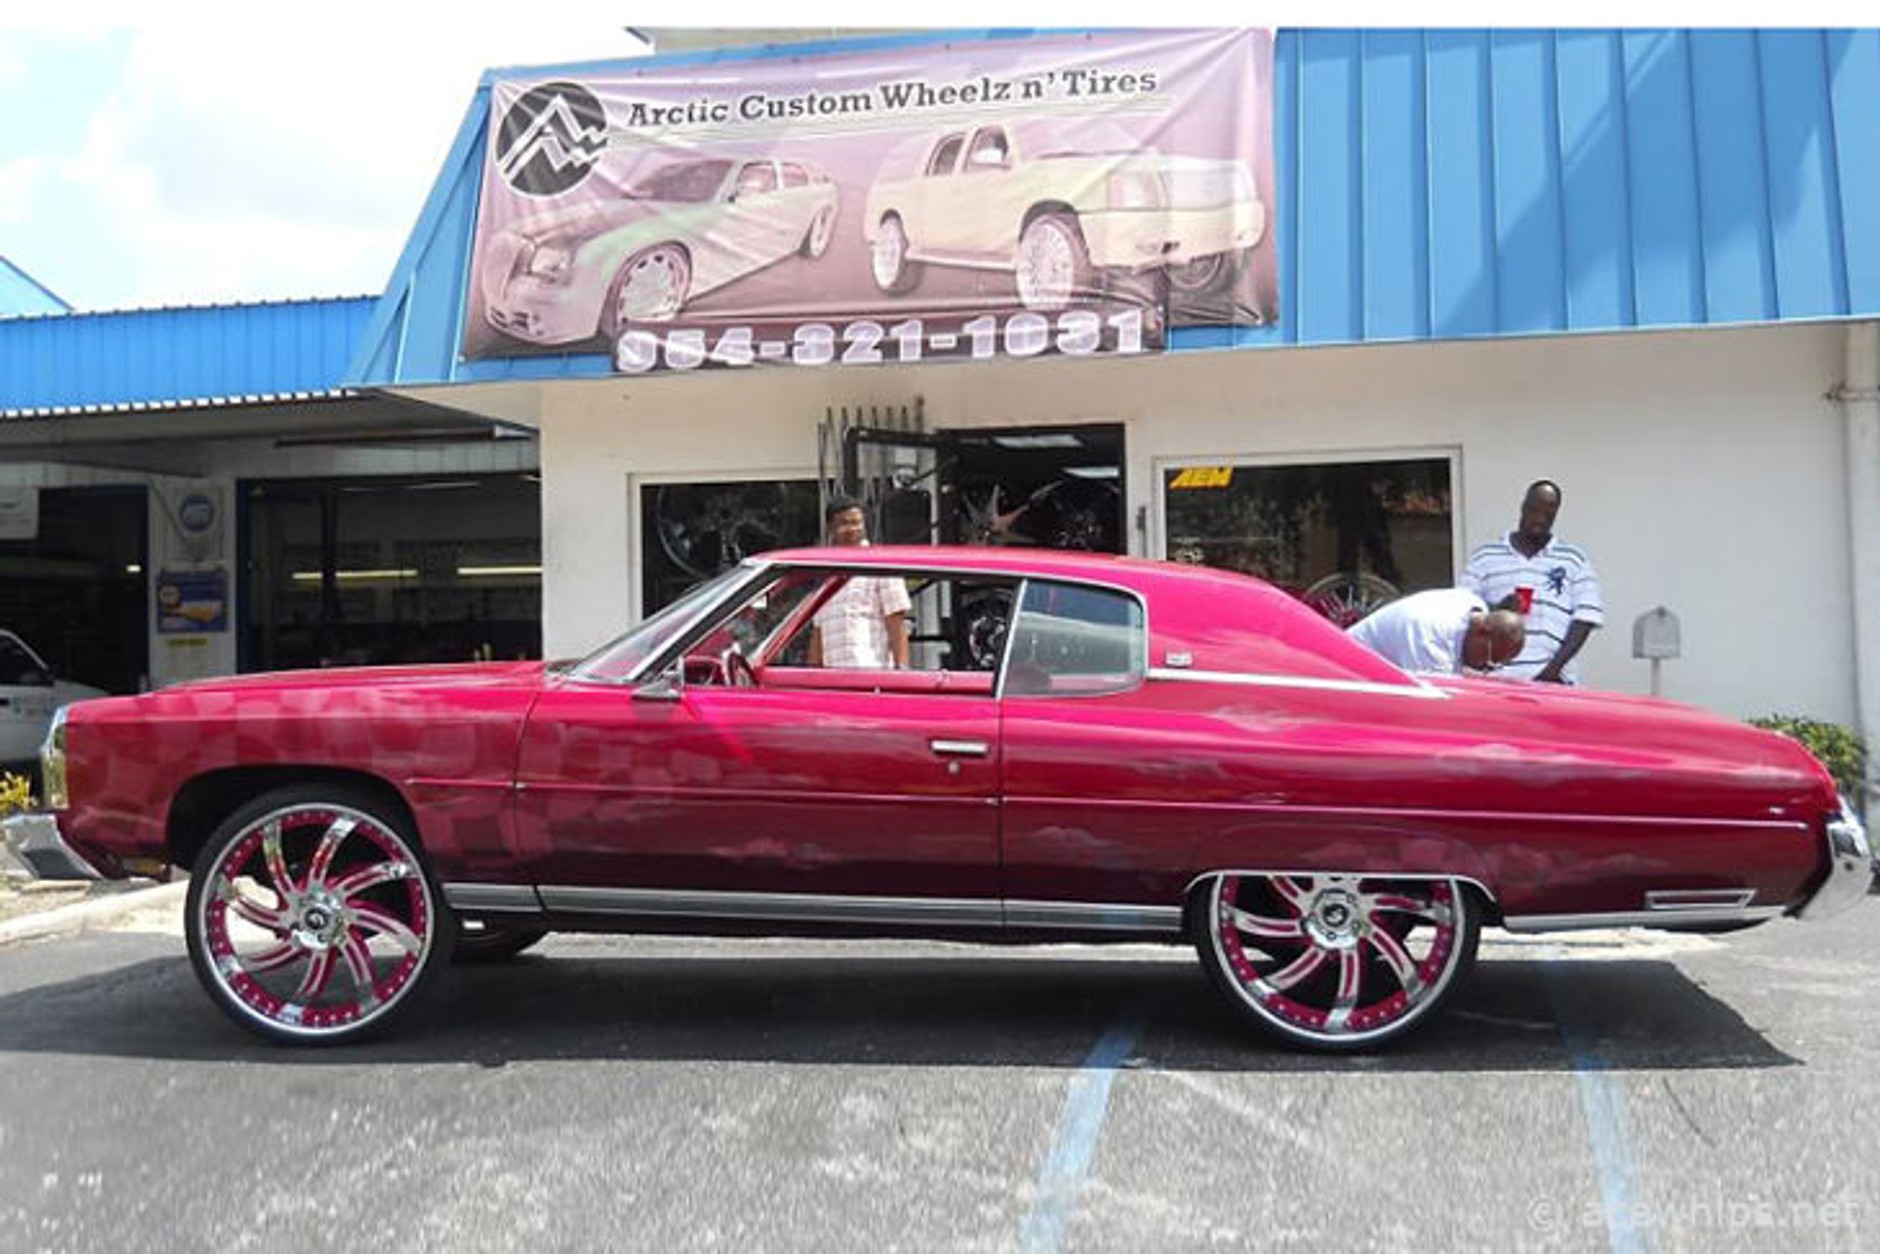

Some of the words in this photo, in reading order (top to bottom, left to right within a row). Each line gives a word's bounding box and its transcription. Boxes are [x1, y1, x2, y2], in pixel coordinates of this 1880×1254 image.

[627, 99, 729, 127] Arctic
[740, 92, 872, 120] Custom
[880, 77, 1011, 109] Wheelz
[1062, 69, 1157, 97] Tires
[617, 308, 1142, 373] 954-321-1031
